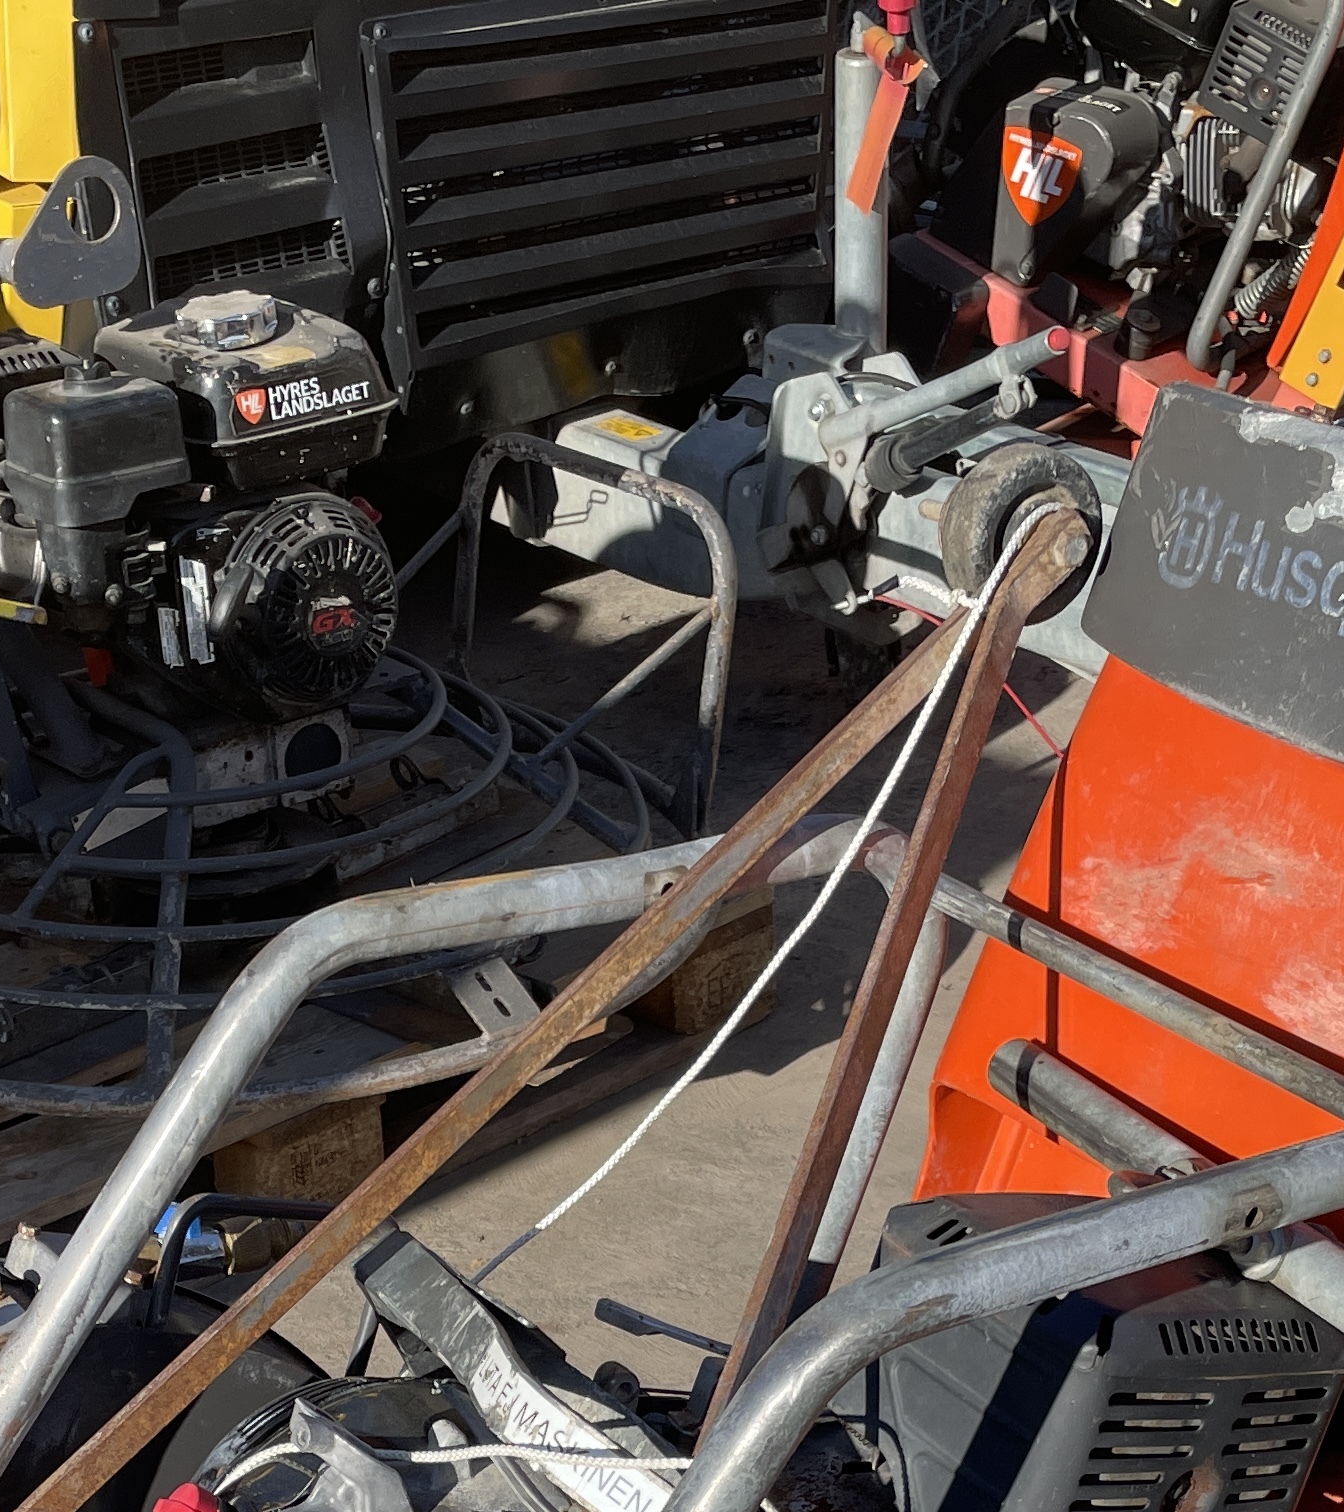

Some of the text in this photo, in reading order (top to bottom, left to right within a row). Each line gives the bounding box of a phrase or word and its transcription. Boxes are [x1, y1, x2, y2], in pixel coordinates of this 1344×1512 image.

[1010, 146, 1064, 204] HLL
[268, 377, 320, 404] HYRES
[270, 381, 370, 421] LANDSLAGET
